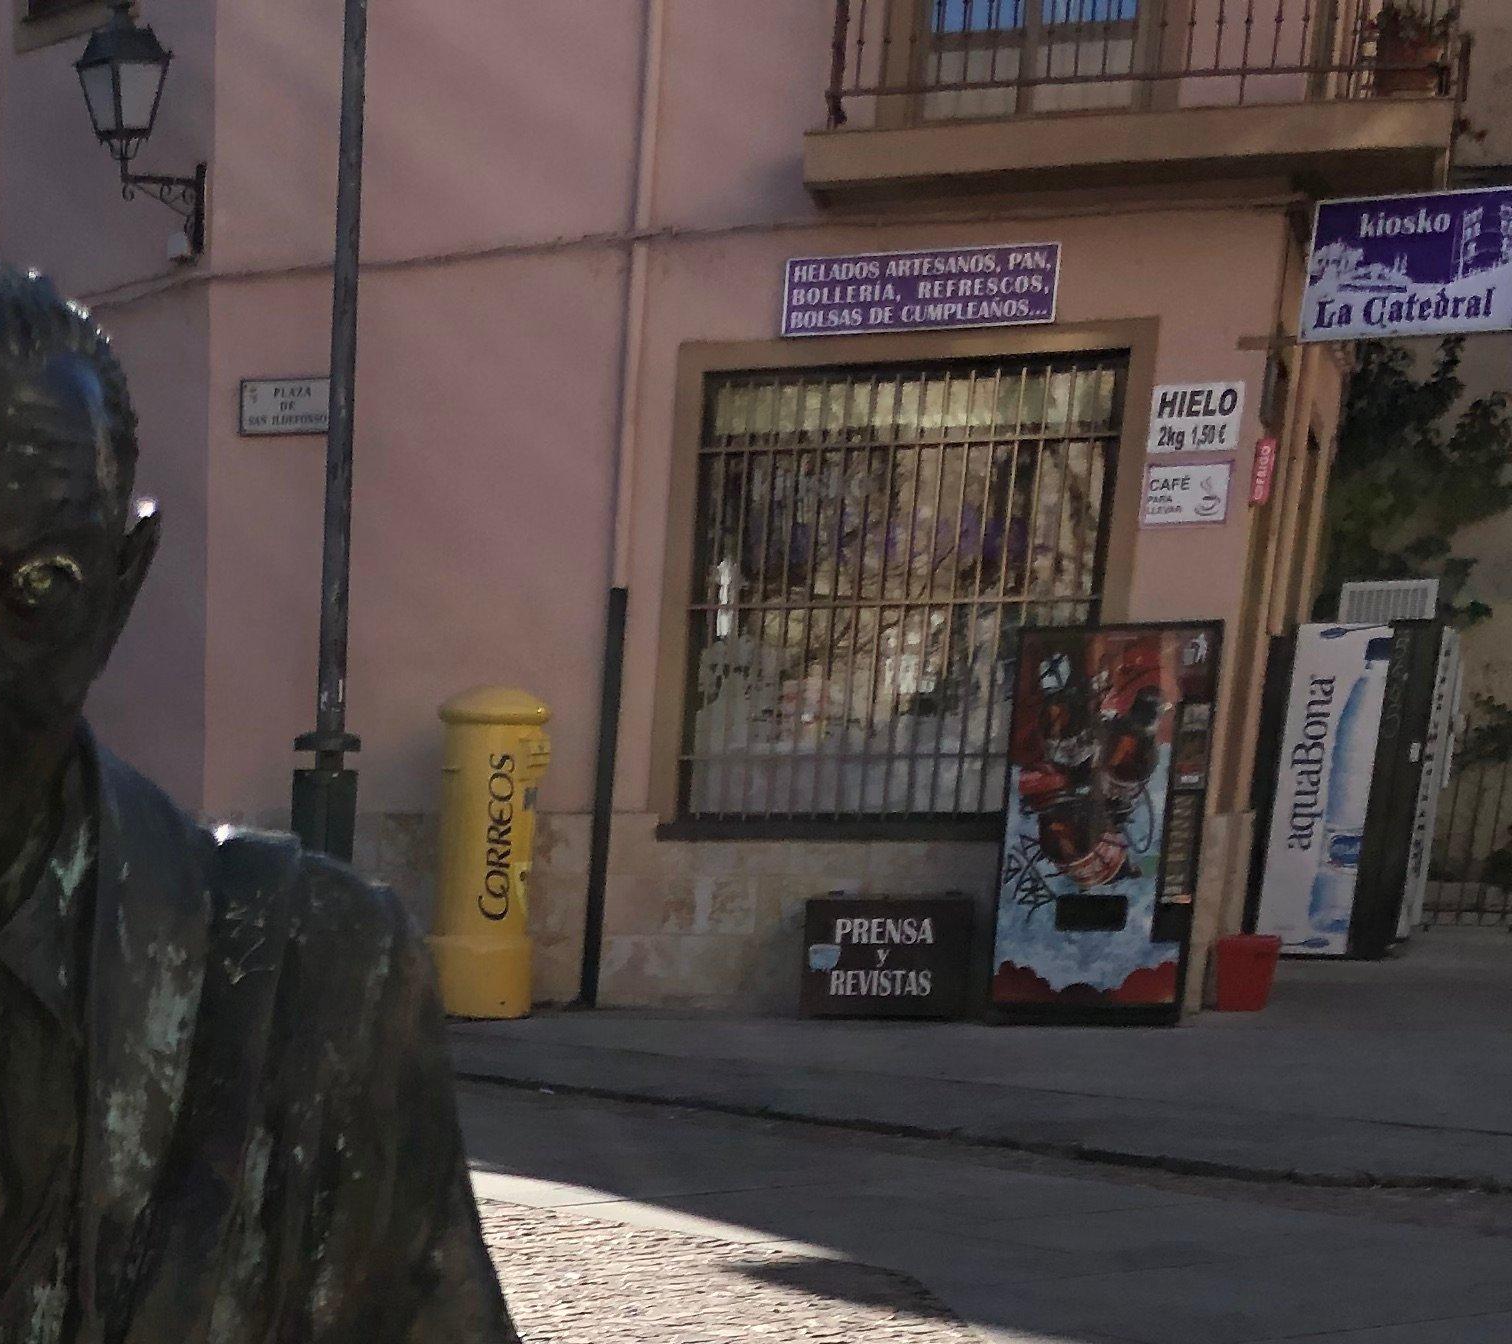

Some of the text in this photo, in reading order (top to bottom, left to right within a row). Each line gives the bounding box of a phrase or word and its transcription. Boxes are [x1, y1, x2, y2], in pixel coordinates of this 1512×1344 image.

[1360, 207, 1451, 238] kiosko
[793, 250, 1052, 283] HELADOS ARTESANOS, PAN,
[791, 275, 1050, 306] BOLLERÍA, REFRESCOS,
[790, 308, 863, 329] BOLSAS
[869, 305, 894, 325] DE
[1313, 286, 1497, 329] La Catedral
[273, 386, 312, 398] PLAZA
[280, 400, 296, 411] DE
[1157, 388, 1238, 419] HIELO
[1158, 424, 1185, 450] 2kg
[1149, 474, 1191, 492] CAFÉ
[1288, 672, 1336, 852] aquaBona
[478, 752, 515, 921] CORREOS
[835, 917, 934, 944] PRENSA
[876, 949, 890, 967] y
[829, 970, 932, 997] REVISTAS
